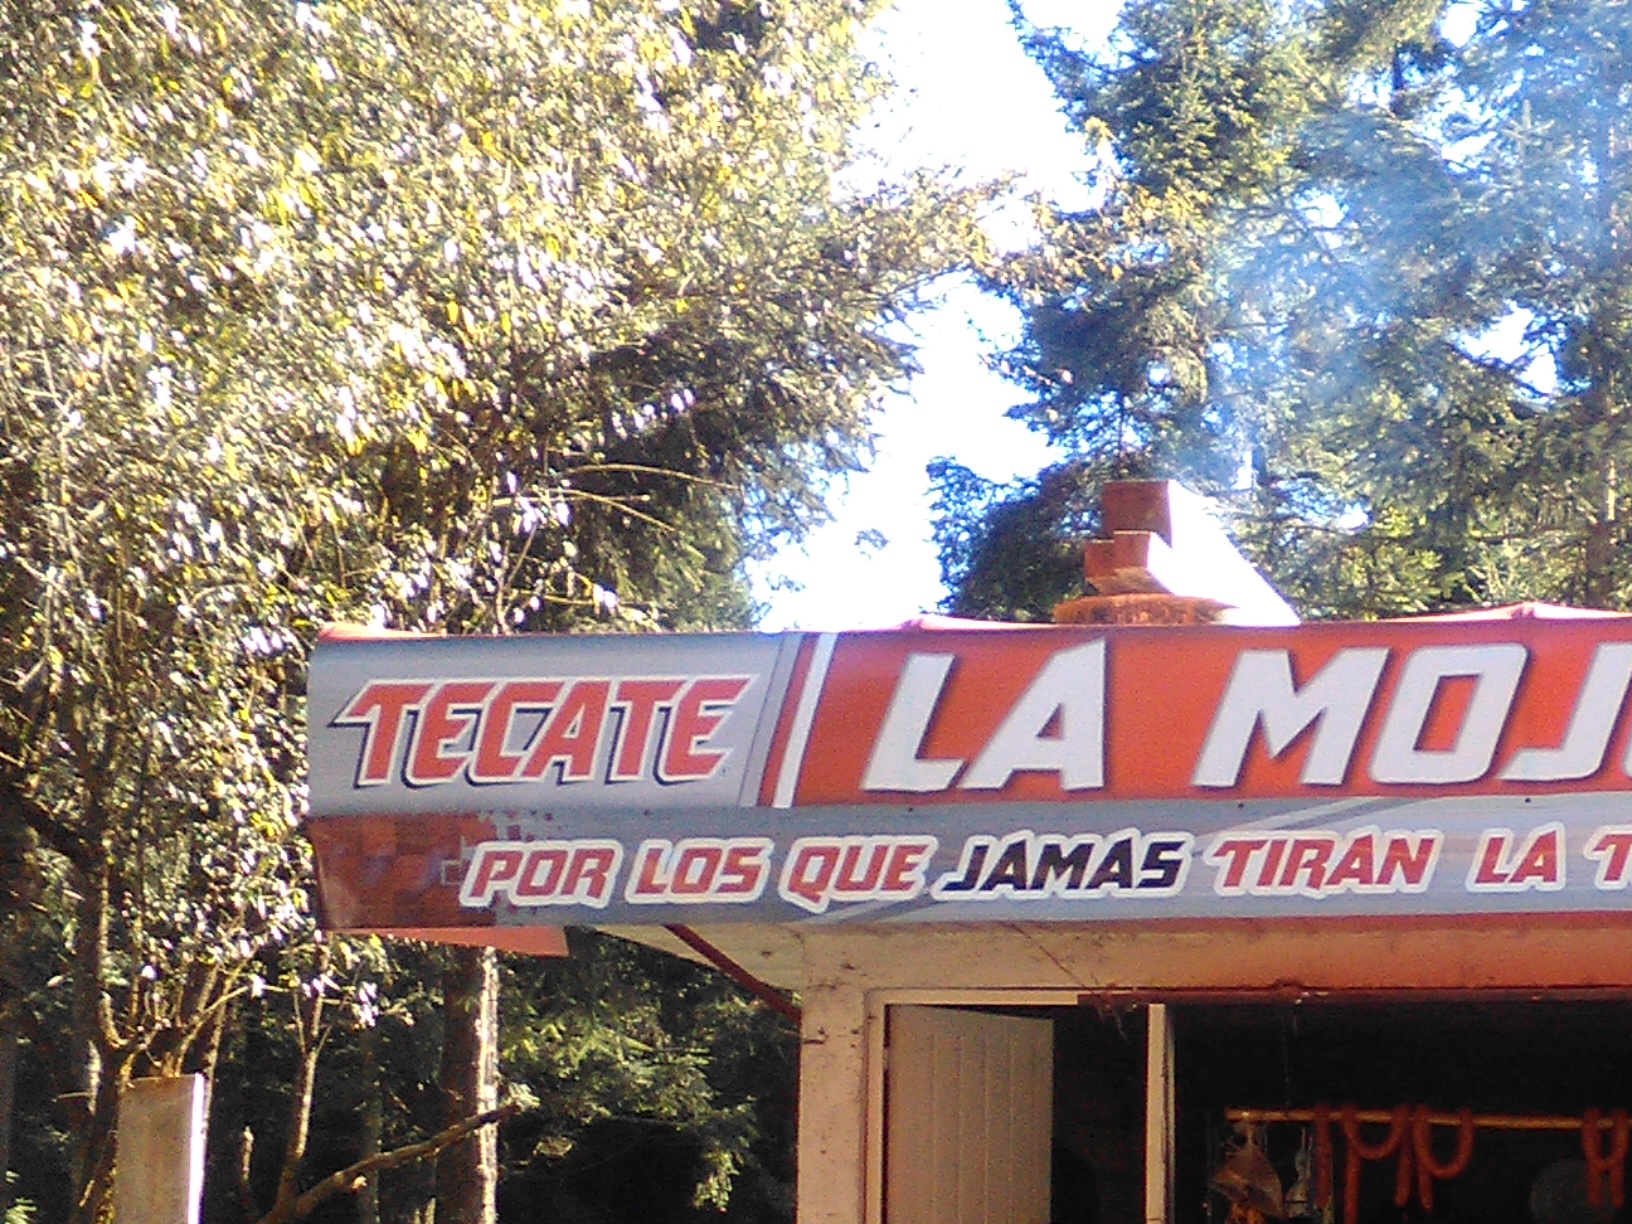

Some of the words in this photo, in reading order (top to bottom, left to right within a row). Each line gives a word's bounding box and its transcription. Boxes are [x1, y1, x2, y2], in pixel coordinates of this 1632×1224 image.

[336, 675, 761, 788] TECATE
[862, 637, 1106, 793] LA
[463, 842, 619, 904] POR
[629, 840, 770, 901] LOS
[782, 838, 934, 908] QUE
[937, 830, 1190, 897] JAMAS
[1210, 826, 1440, 897] TIRAN
[1468, 824, 1564, 888] LA
